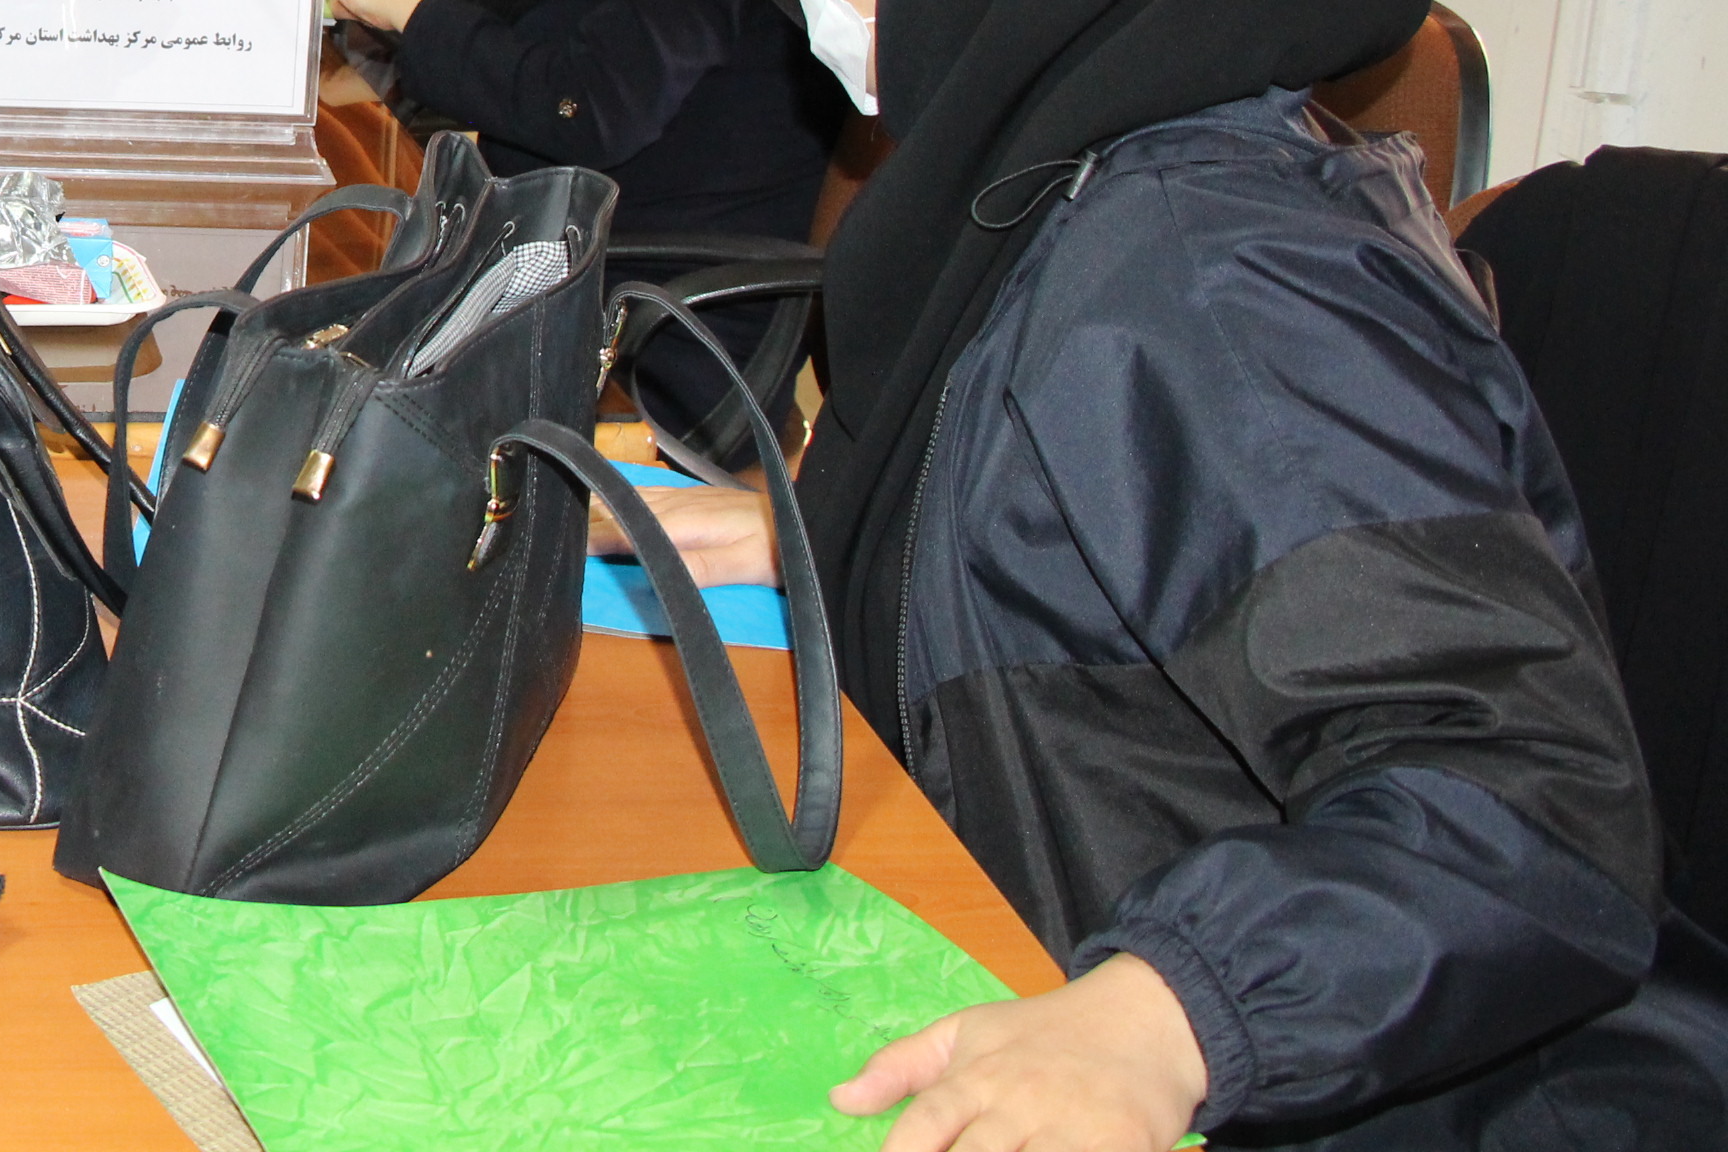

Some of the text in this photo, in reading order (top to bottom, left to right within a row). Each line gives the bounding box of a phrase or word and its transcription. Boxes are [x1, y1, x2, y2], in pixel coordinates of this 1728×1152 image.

[25, 28, 64, 45] استان
[67, 29, 120, 47] بهداشت
[123, 30, 158, 49] مرکز
[160, 35, 208, 50] عمومی
[212, 32, 253, 52] روابط
